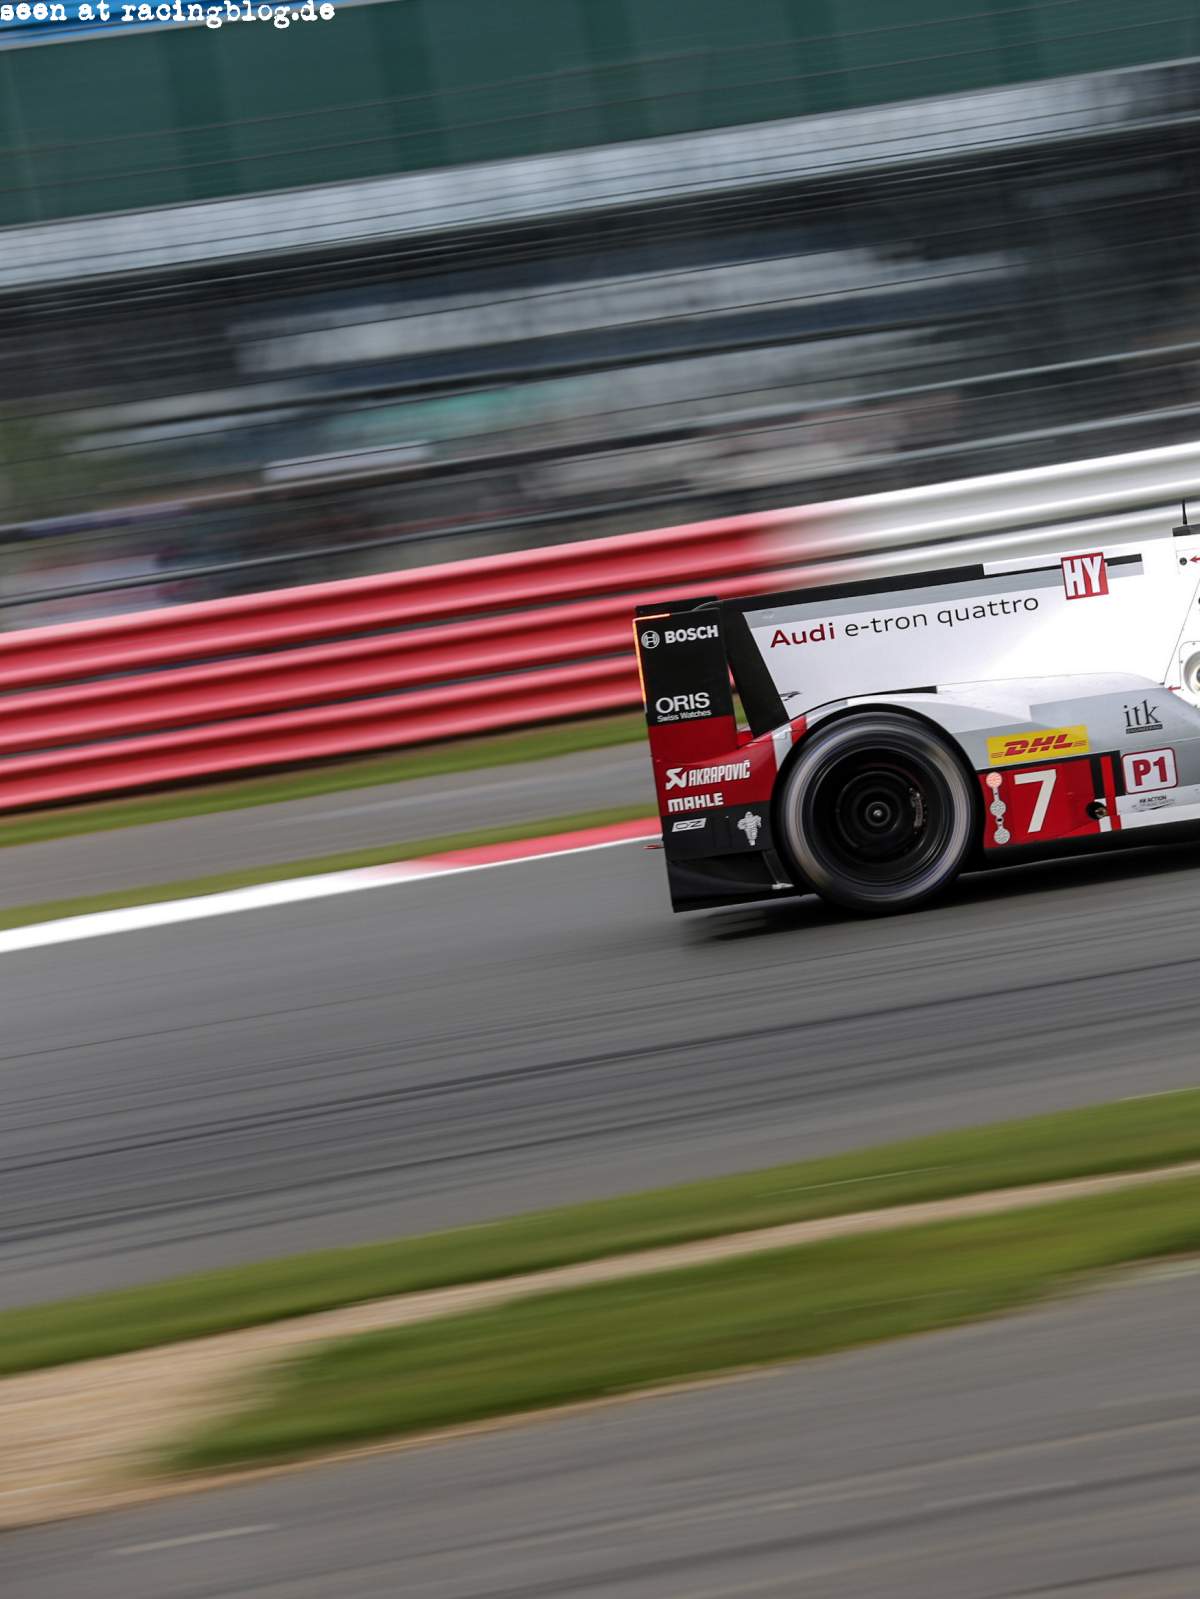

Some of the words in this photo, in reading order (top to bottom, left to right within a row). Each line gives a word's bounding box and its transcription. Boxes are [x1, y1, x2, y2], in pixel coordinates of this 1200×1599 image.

[1063, 556, 1105, 599] HY
[664, 625, 719, 644] BOSCH
[770, 622, 835, 648] Audi
[844, 612, 928, 637] e-tron
[936, 597, 1039, 627] quattro
[655, 692, 711, 714] ORIS
[657, 714, 680, 723] Swiss
[679, 709, 712, 719] Watches
[1123, 699, 1161, 728] itk
[1004, 734, 1073, 757] DHL
[1132, 756, 1168, 787] P1
[667, 792, 724, 813] MAHLE
[1014, 769, 1057, 833] 7
